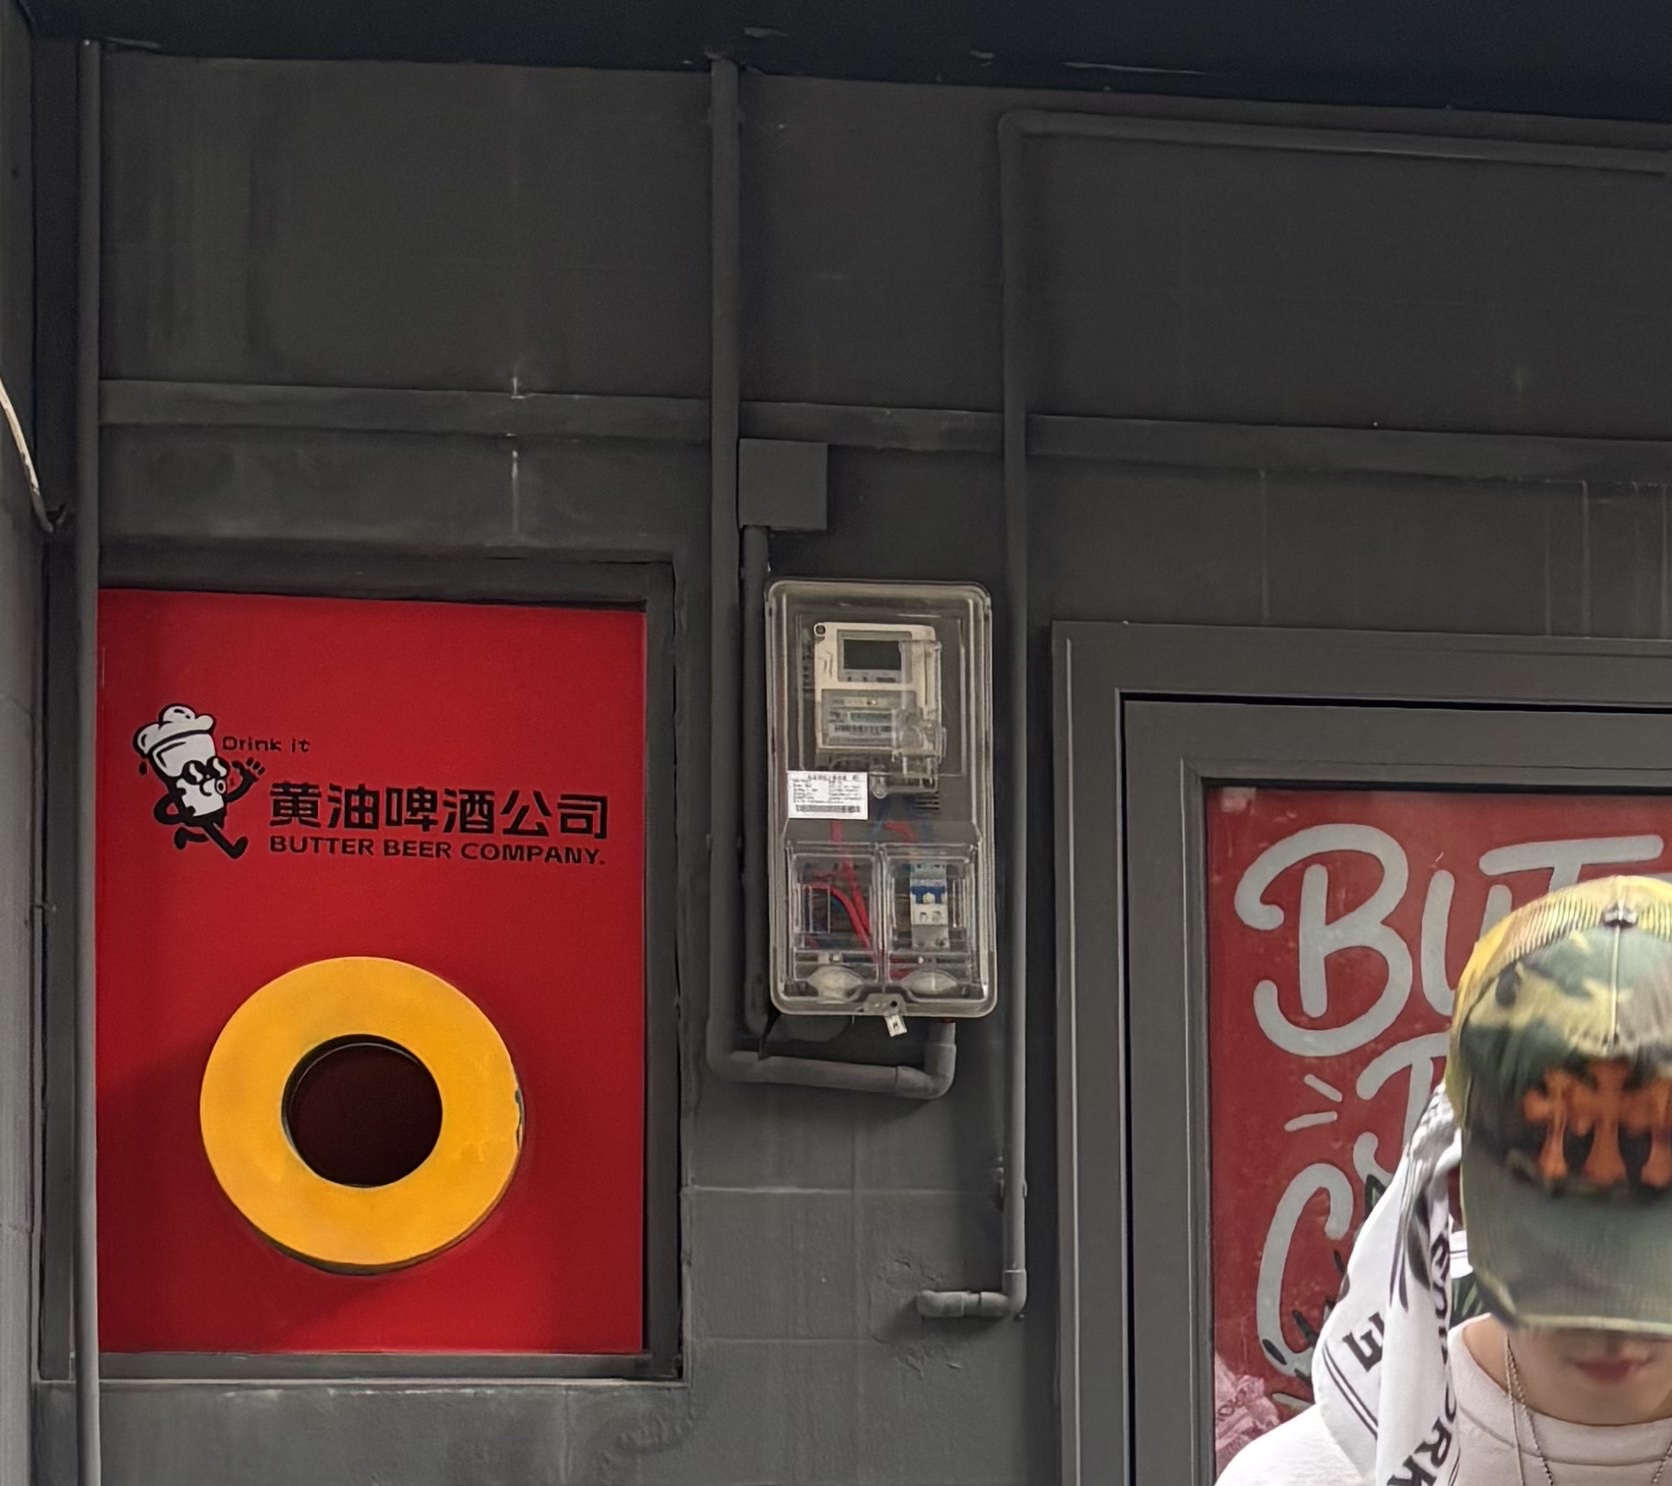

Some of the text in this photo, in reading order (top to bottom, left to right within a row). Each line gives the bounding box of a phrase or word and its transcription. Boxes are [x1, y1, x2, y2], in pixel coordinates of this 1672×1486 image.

[222, 736, 310, 753] Drink it
[269, 780, 608, 840] 黄油啤酒公司
[270, 835, 374, 856] BUTTER
[383, 839, 452, 860] BEER
